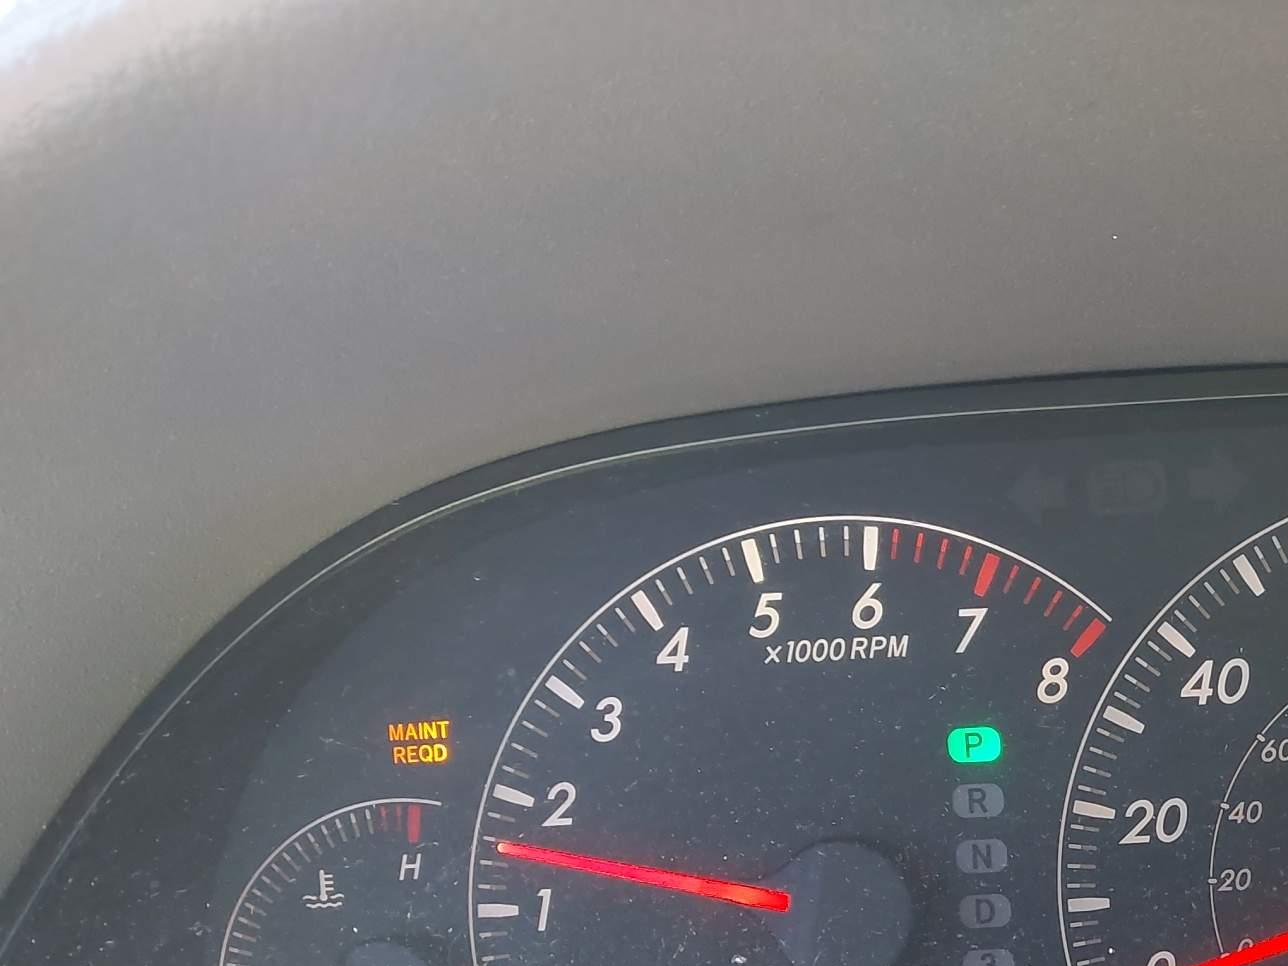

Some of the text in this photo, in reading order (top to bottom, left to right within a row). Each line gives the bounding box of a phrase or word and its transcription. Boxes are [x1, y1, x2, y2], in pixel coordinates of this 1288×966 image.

[749, 592, 782, 638] 5
[852, 582, 884, 629] 6
[850, 635, 909, 660] RPM
[955, 608, 988, 653] 7
[656, 627, 689, 671] 4
[1037, 657, 1069, 703] 8
[1180, 658, 1250, 705] 40
[388, 720, 450, 742] MAINT
[590, 697, 624, 742] 3
[393, 744, 448, 764] REQD
[964, 733, 983, 758] P
[542, 781, 577, 827] 2
[967, 787, 988, 814] R
[1228, 801, 1263, 824] 40
[1118, 798, 1187, 844] 20
[399, 853, 422, 880] H
[971, 844, 992, 869] N
[1217, 869, 1251, 892] 20
[536, 888, 552, 931] 1
[975, 903, 995, 923] D
